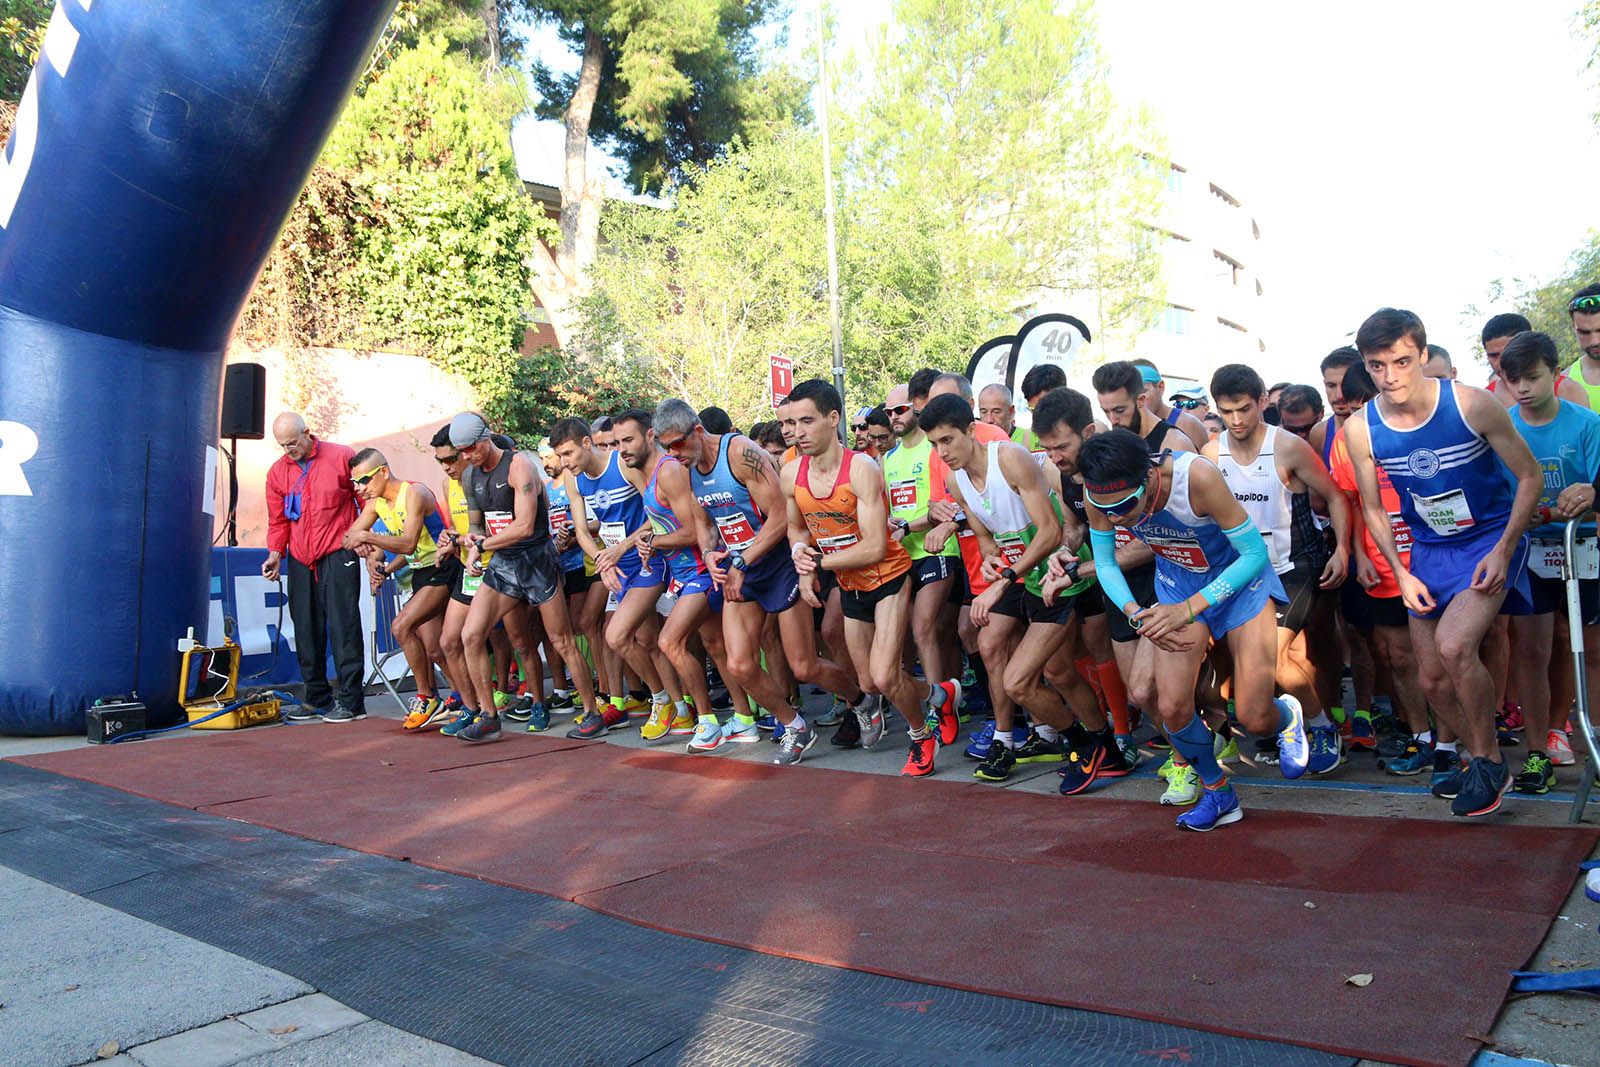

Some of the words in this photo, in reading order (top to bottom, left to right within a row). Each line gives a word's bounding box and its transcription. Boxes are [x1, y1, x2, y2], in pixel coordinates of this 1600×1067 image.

[1041, 329, 1072, 354] 40
[993, 351, 1010, 375] 4
[779, 370, 785, 387] 1
[1427, 509, 1454, 518] JOAN
[1430, 517, 1456, 526] 1158
[723, 525, 745, 536] OSCAR
[1161, 549, 1191, 558] EMILE
